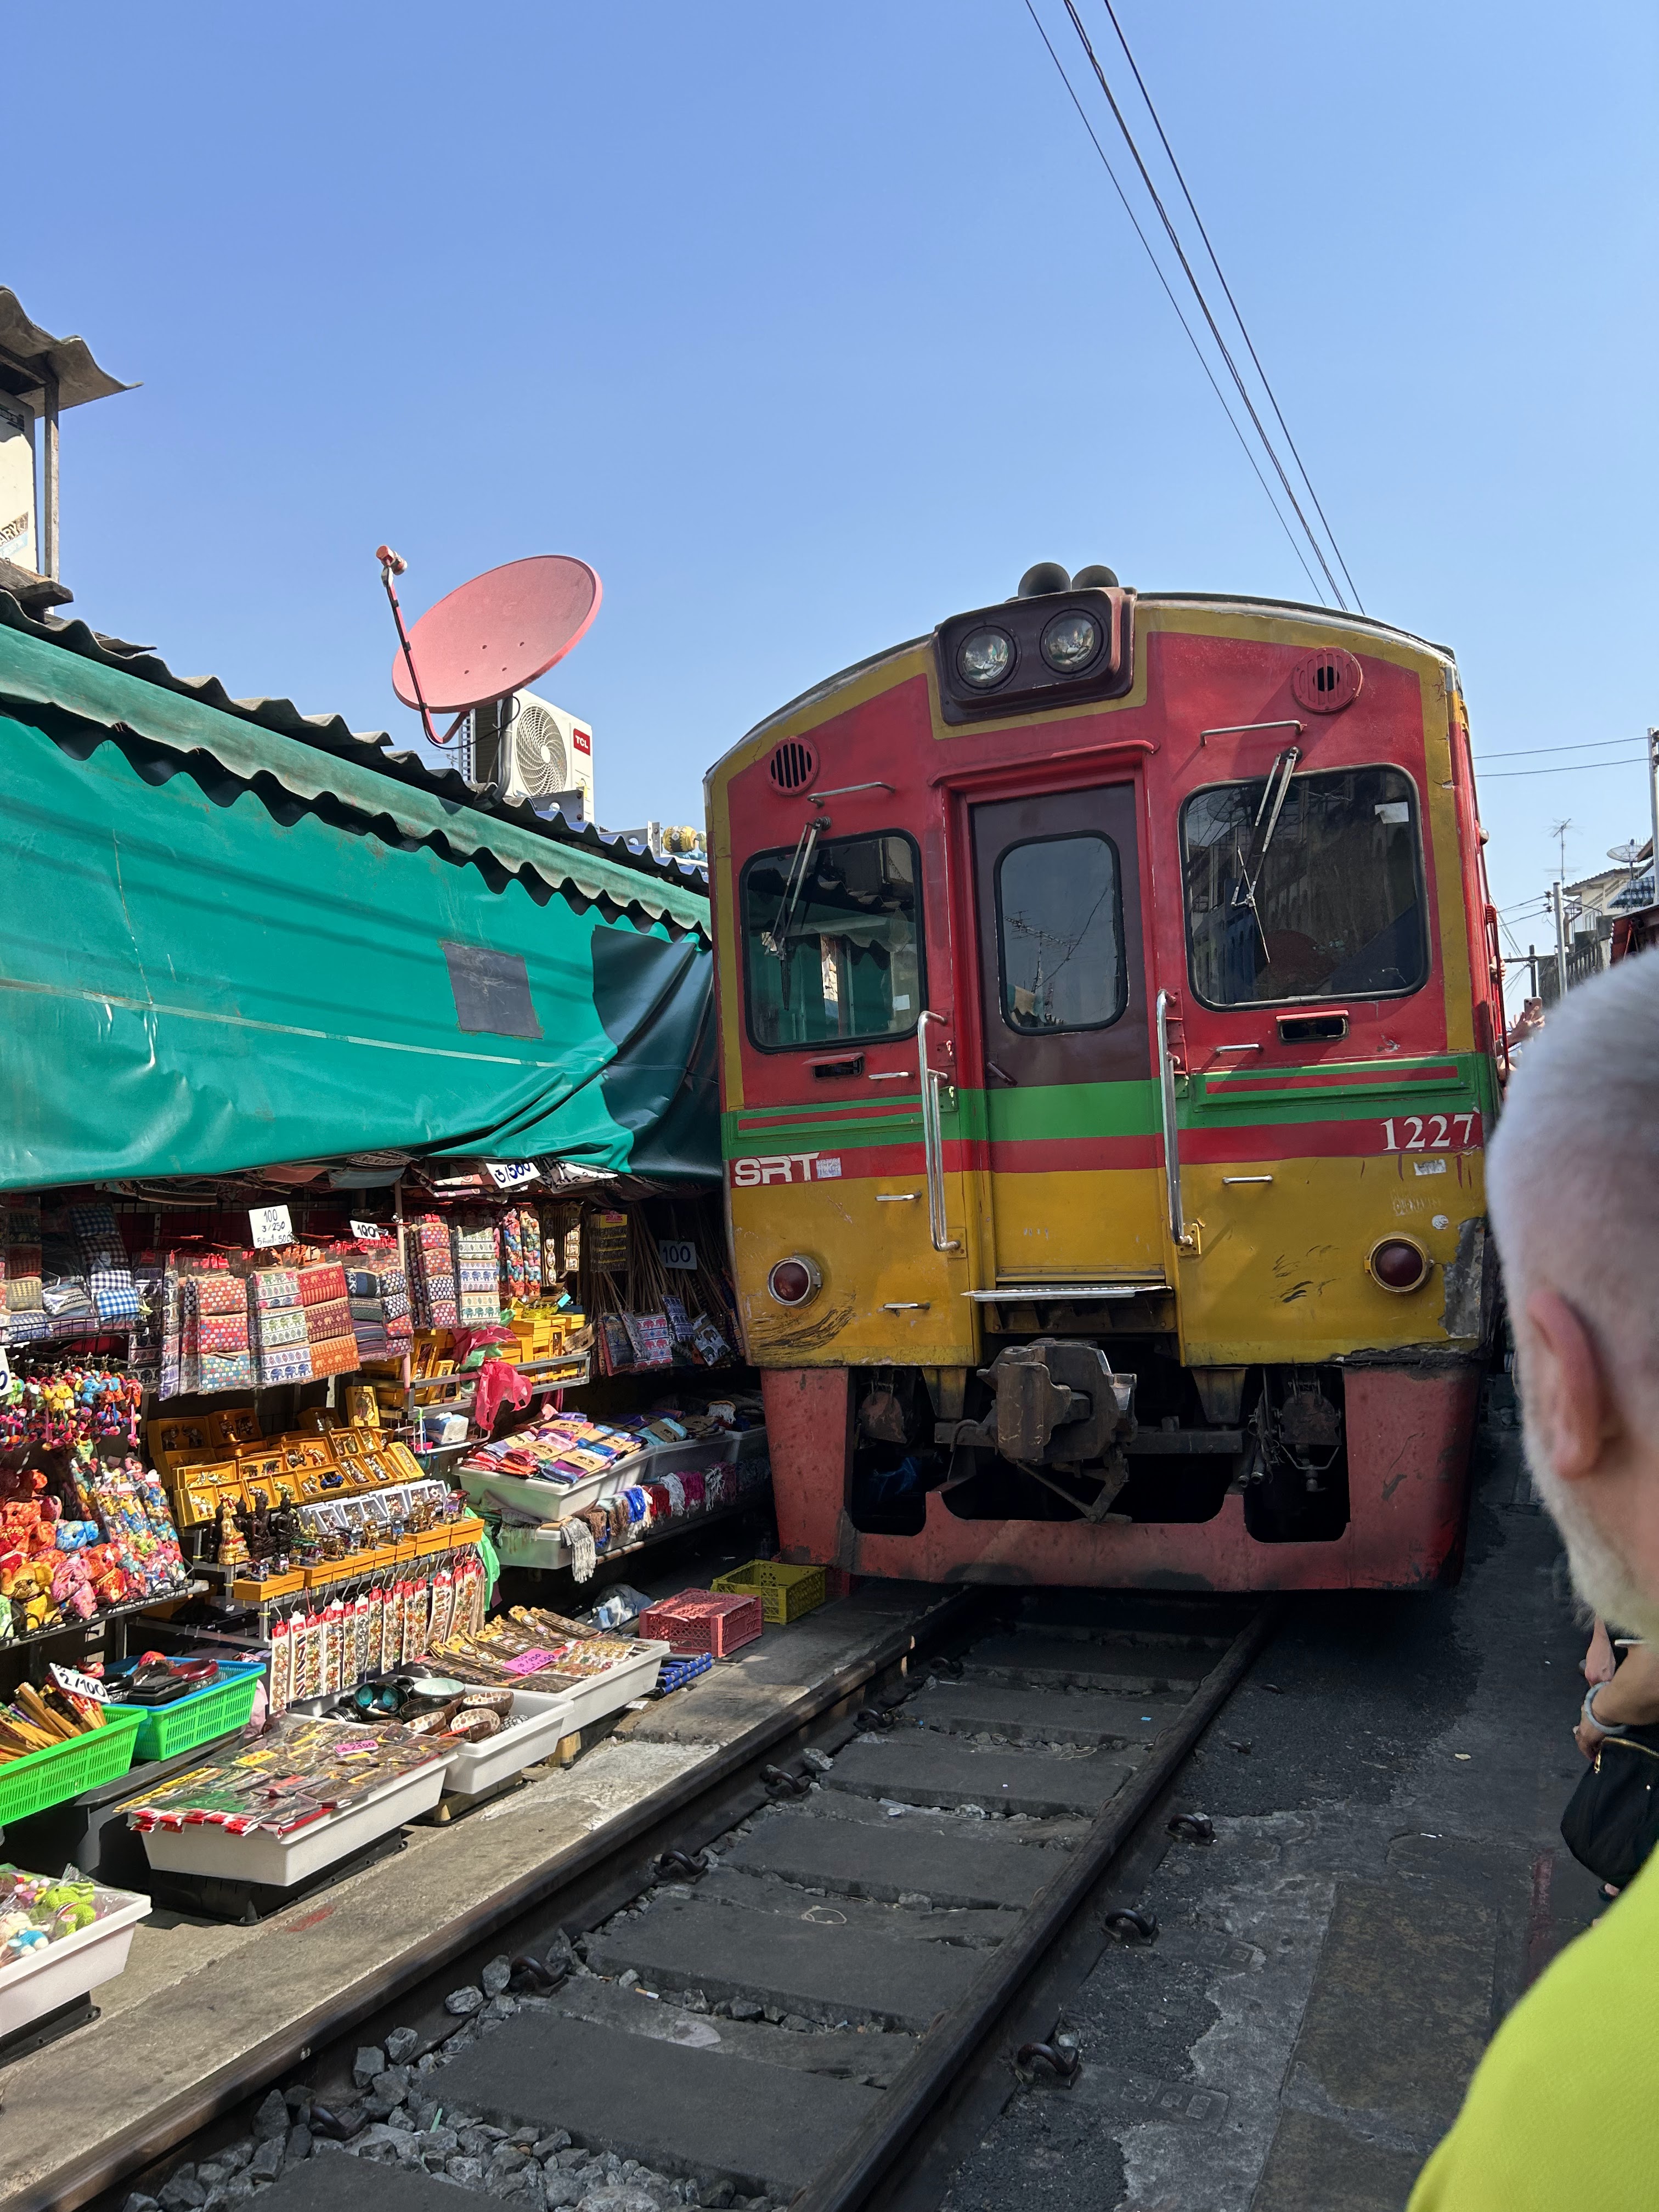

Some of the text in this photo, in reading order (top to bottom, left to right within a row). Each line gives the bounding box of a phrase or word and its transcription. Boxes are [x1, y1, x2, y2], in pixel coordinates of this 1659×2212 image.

[575, 735, 589, 749] TCL
[1380, 1113, 1475, 1150] 1227
[735, 1152, 820, 1186] SRT
[264, 1209, 278, 1222] 100
[357, 1224, 376, 1238] 100
[663, 1245, 691, 1263] 100
[59, 1672, 106, 1697] 2/100
